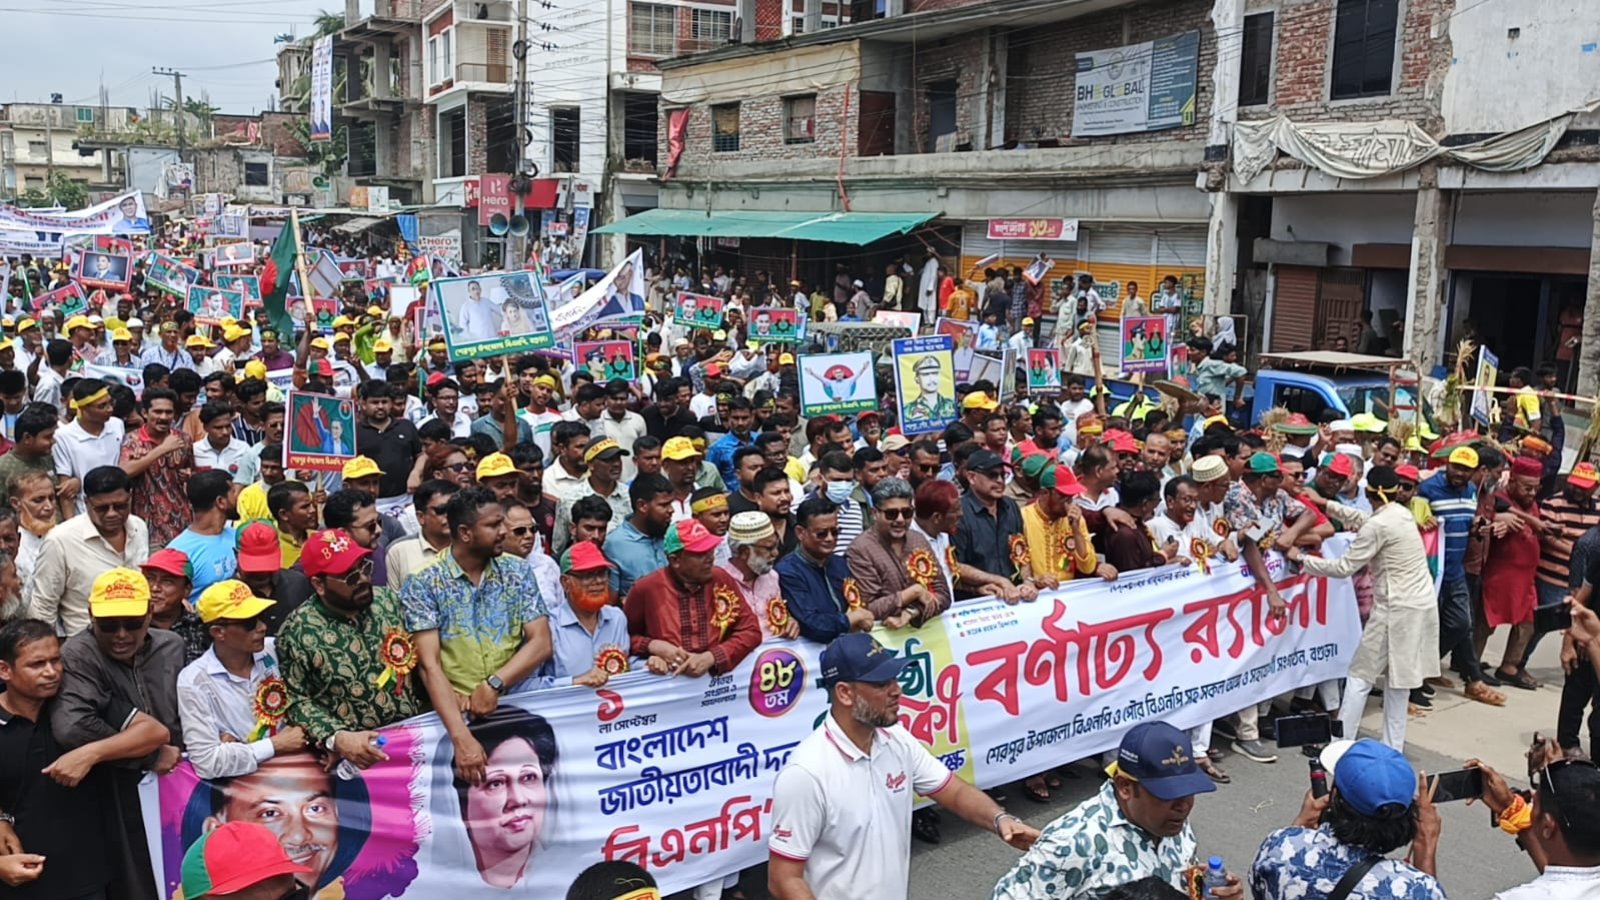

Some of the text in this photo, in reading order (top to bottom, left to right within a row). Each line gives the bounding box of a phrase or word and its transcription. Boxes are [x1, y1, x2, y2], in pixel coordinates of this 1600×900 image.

[482, 196, 509, 206] Hero
[427, 238, 452, 246] Hero
[965, 598, 1174, 717] বর্ণাঢ্য
[759, 659, 797, 692] ৪৮
[596, 689, 624, 721] ১
[764, 689, 791, 709] তম
[598, 713, 657, 735] লা সেপ্টেম্বর
[986, 737, 1026, 764] শেরপুর
[1027, 722, 1071, 751] উপজেলা
[1072, 706, 1113, 737] বিএনপি
[1113, 708, 1122, 726] ও
[1122, 700, 1146, 723] পৌর
[1146, 686, 1184, 715] বিএনপি
[1200, 680, 1226, 701] সকল
[595, 715, 729, 771] বাংলাদেশ
[598, 742, 758, 815] জাতীয়তাবাদী
[602, 795, 773, 873] বিএনপি'
